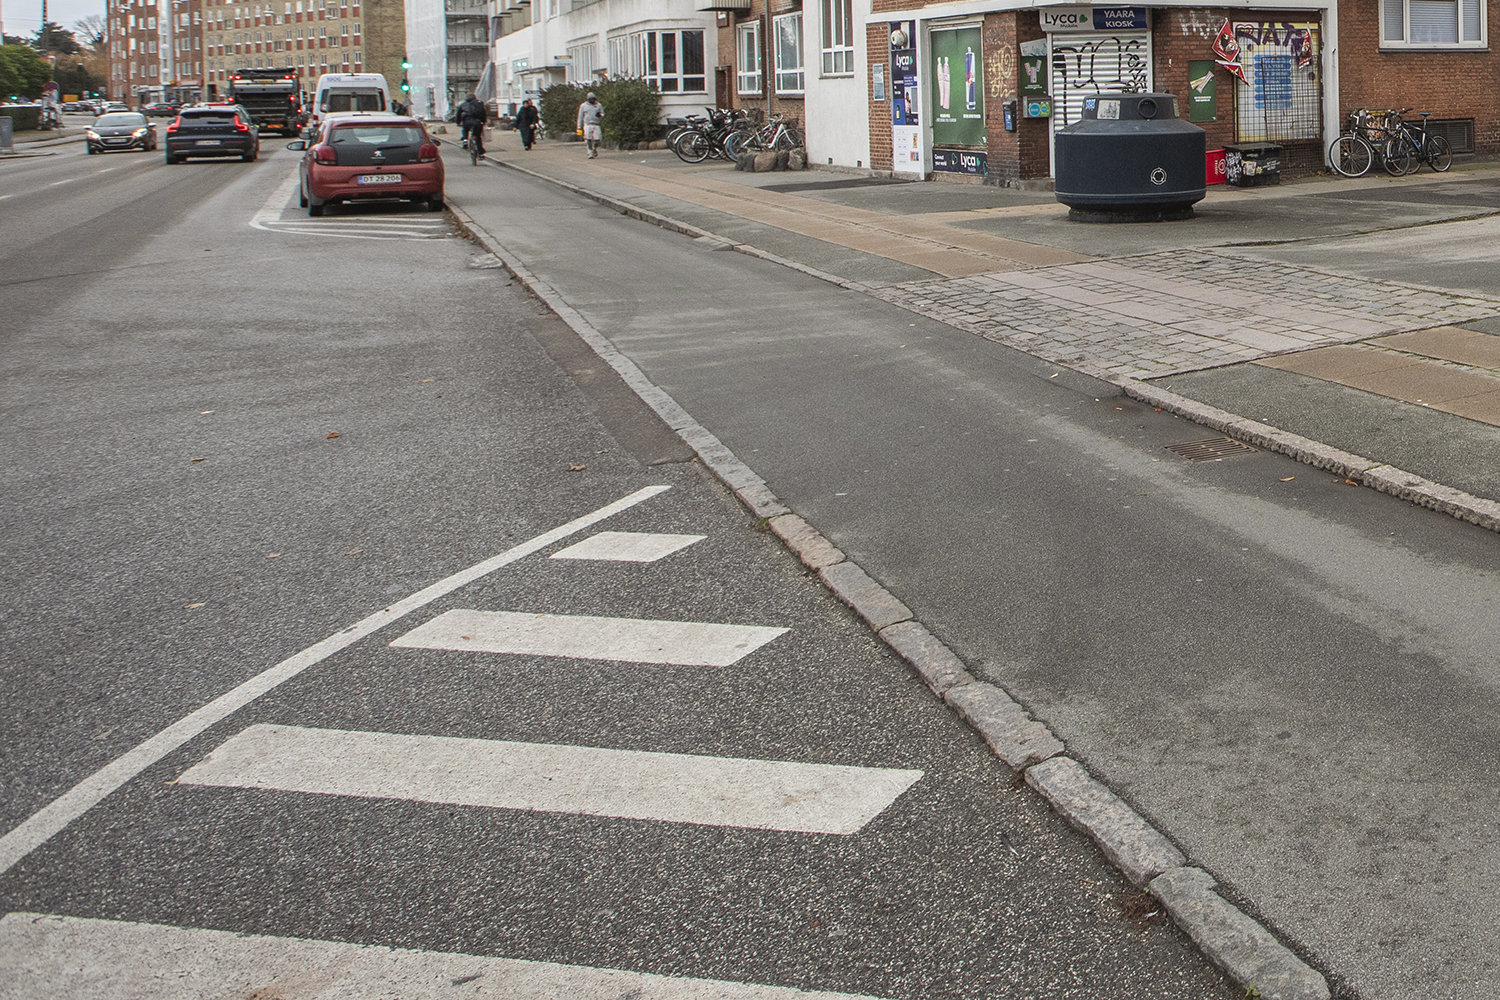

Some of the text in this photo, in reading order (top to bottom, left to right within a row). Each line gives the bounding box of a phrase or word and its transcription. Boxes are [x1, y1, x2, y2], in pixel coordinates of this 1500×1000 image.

[1044, 13, 1077, 25] Lyca
[1104, 10, 1135, 18] YAARA
[896, 54, 910, 67] Lyca
[960, 153, 976, 168] Lyca
